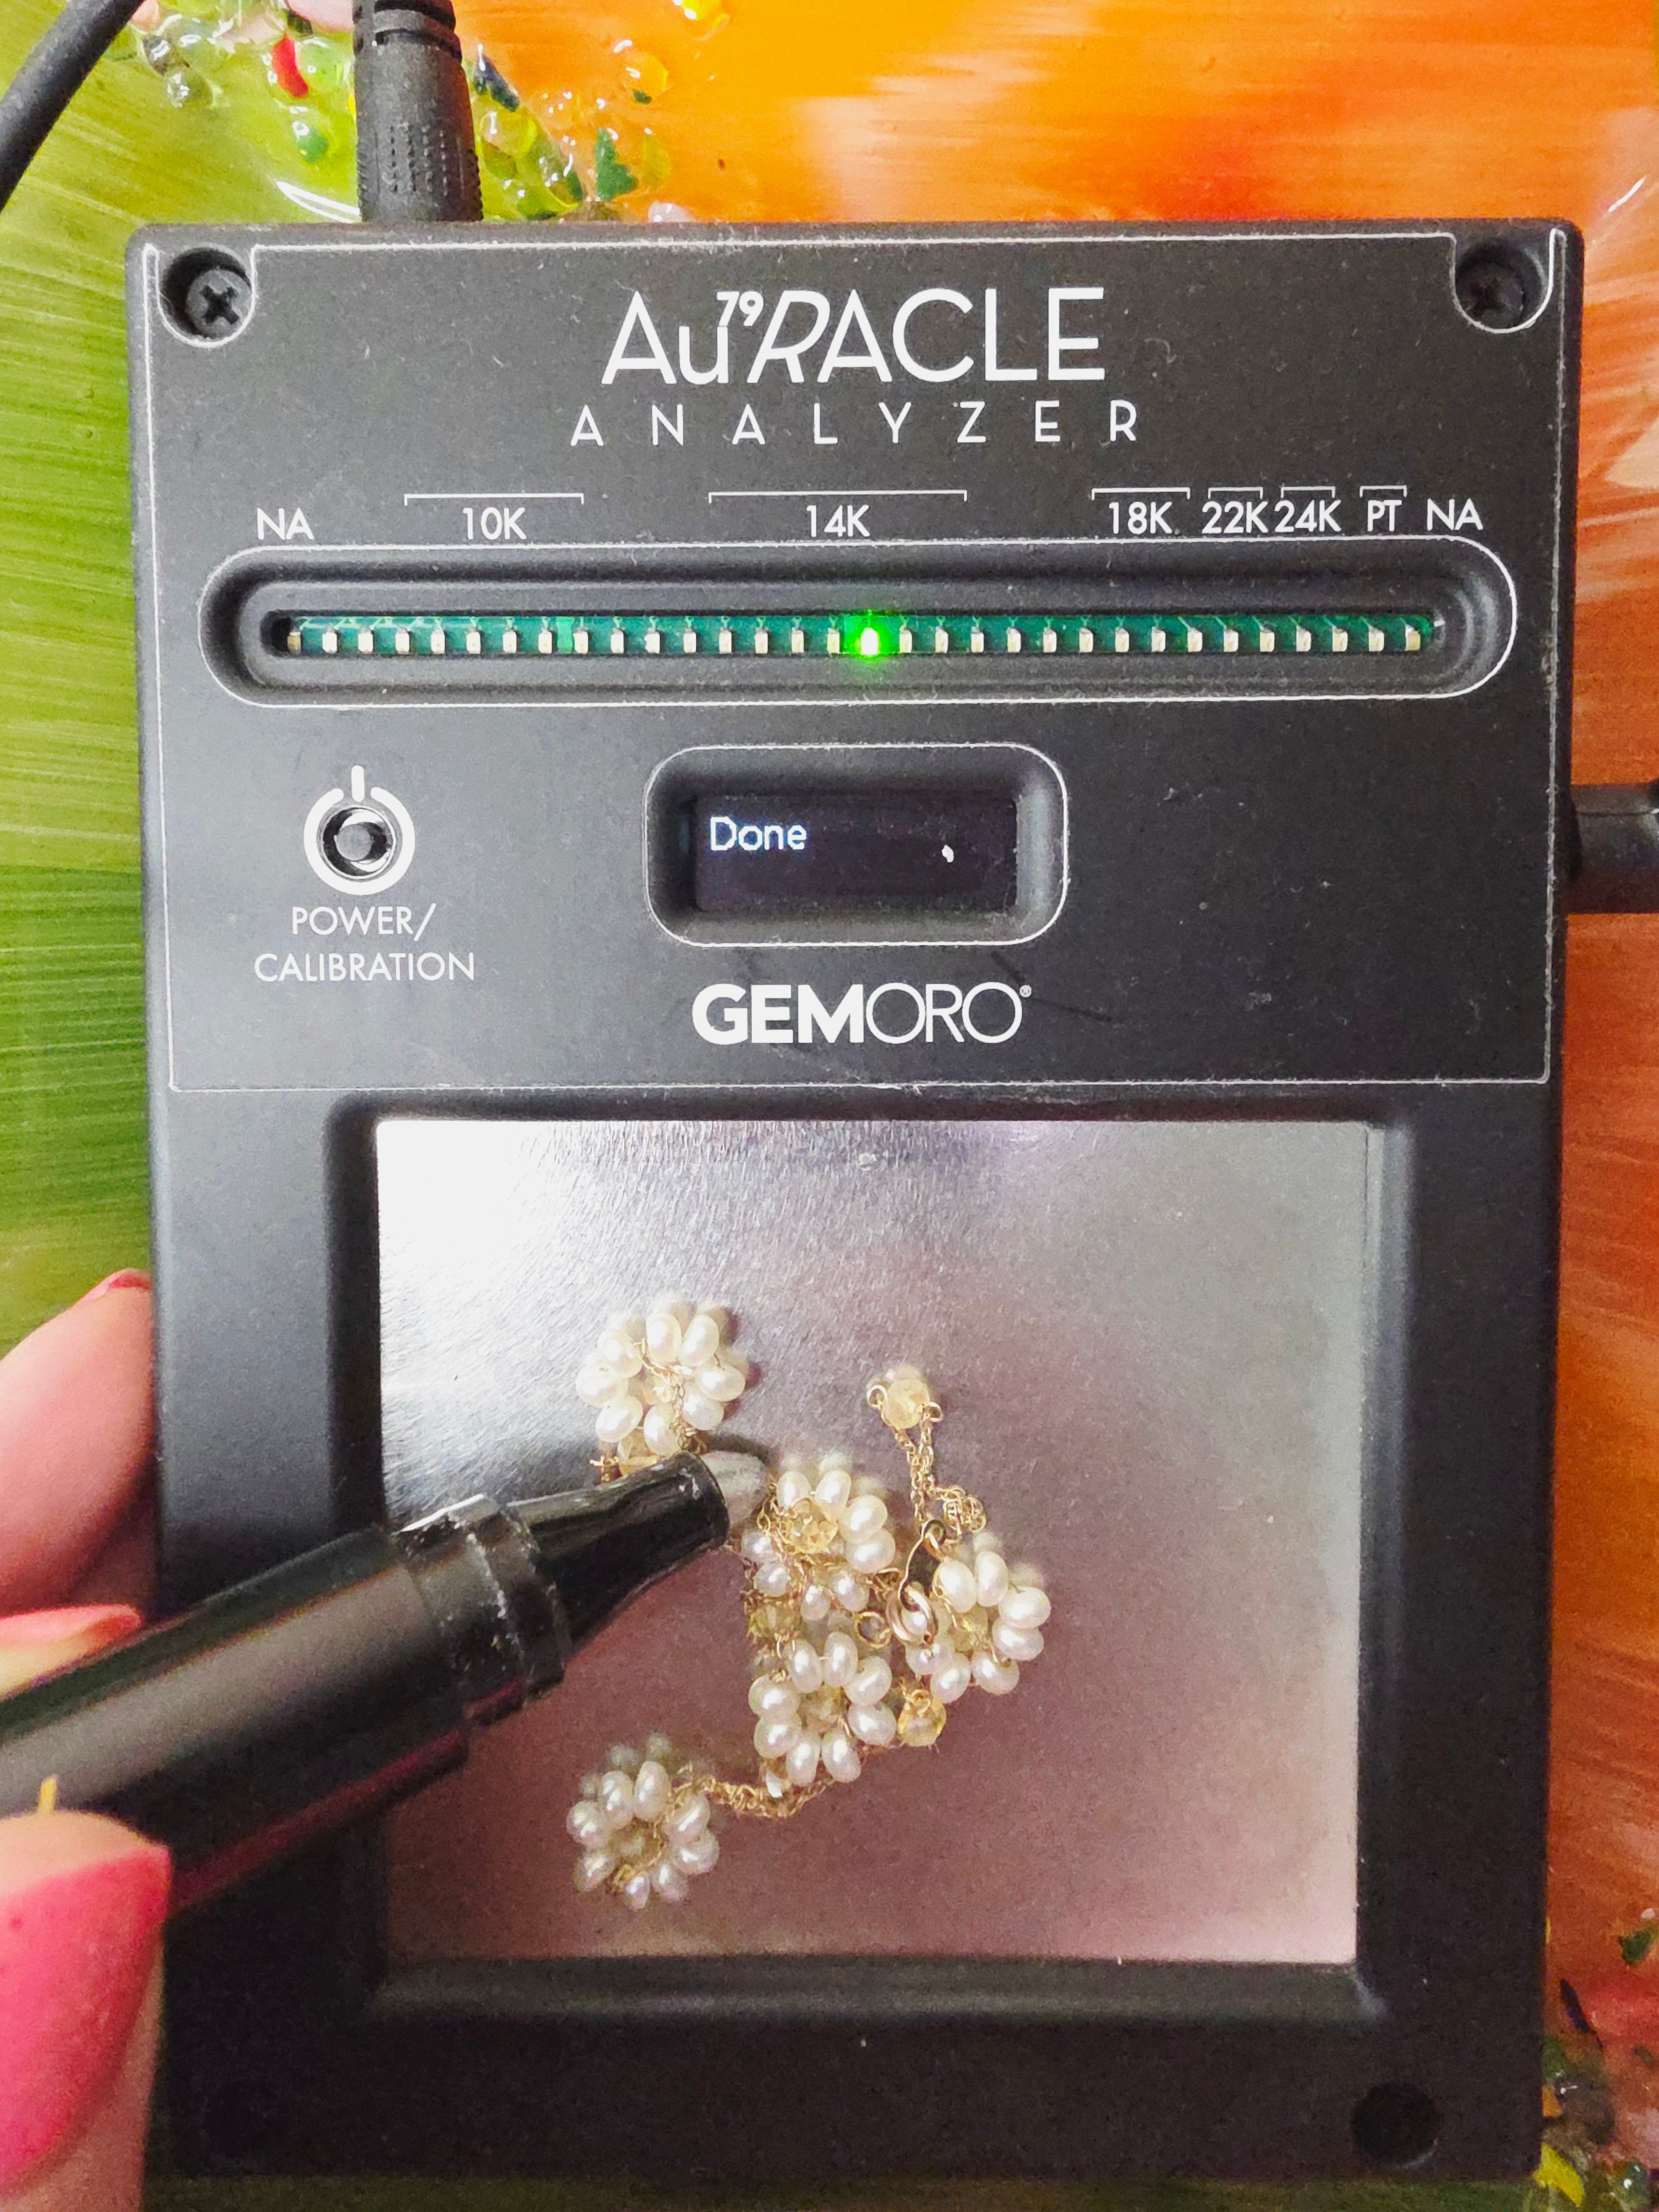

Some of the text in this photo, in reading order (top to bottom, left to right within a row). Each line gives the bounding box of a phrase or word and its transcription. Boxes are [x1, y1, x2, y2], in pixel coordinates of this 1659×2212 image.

[571, 400, 1137, 447] ANALYZER
[257, 498, 1484, 540] NA 10K 14K 18K 22K 24K PT NA
[709, 816, 807, 852] Done
[292, 903, 437, 942] POWER/
[254, 952, 474, 982] CALIBRATION
